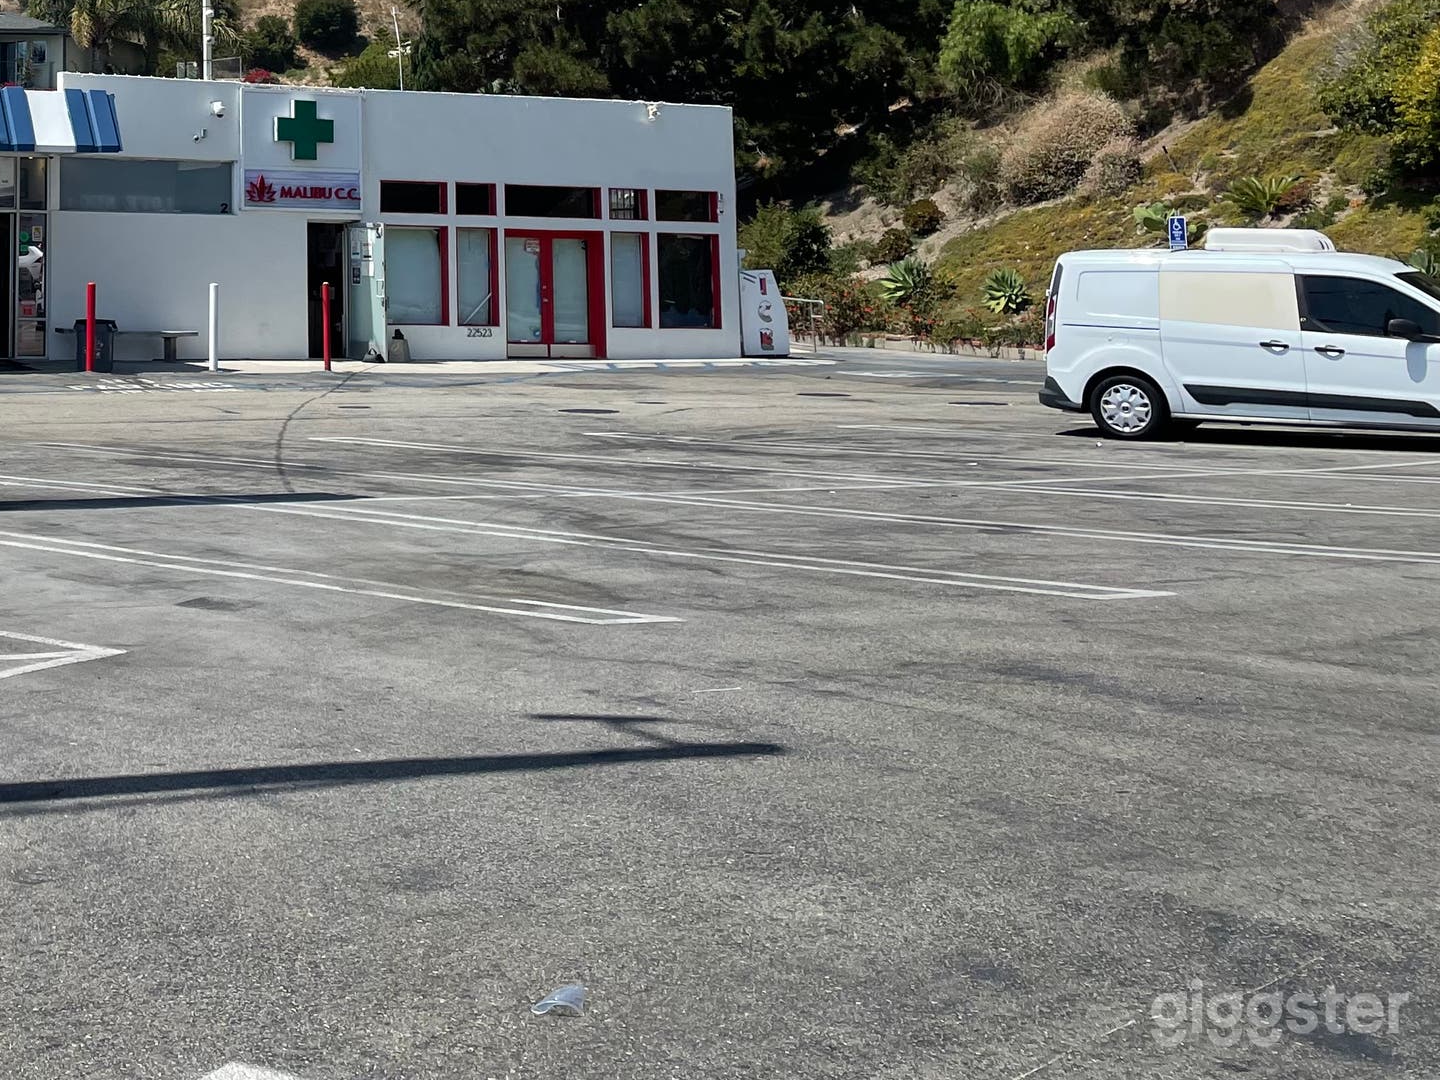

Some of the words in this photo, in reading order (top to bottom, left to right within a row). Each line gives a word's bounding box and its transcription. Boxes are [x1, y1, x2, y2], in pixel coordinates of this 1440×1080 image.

[280, 185, 333, 199] MALIBU
[220, 203, 229, 214] 2
[466, 327, 493, 338] 22523
